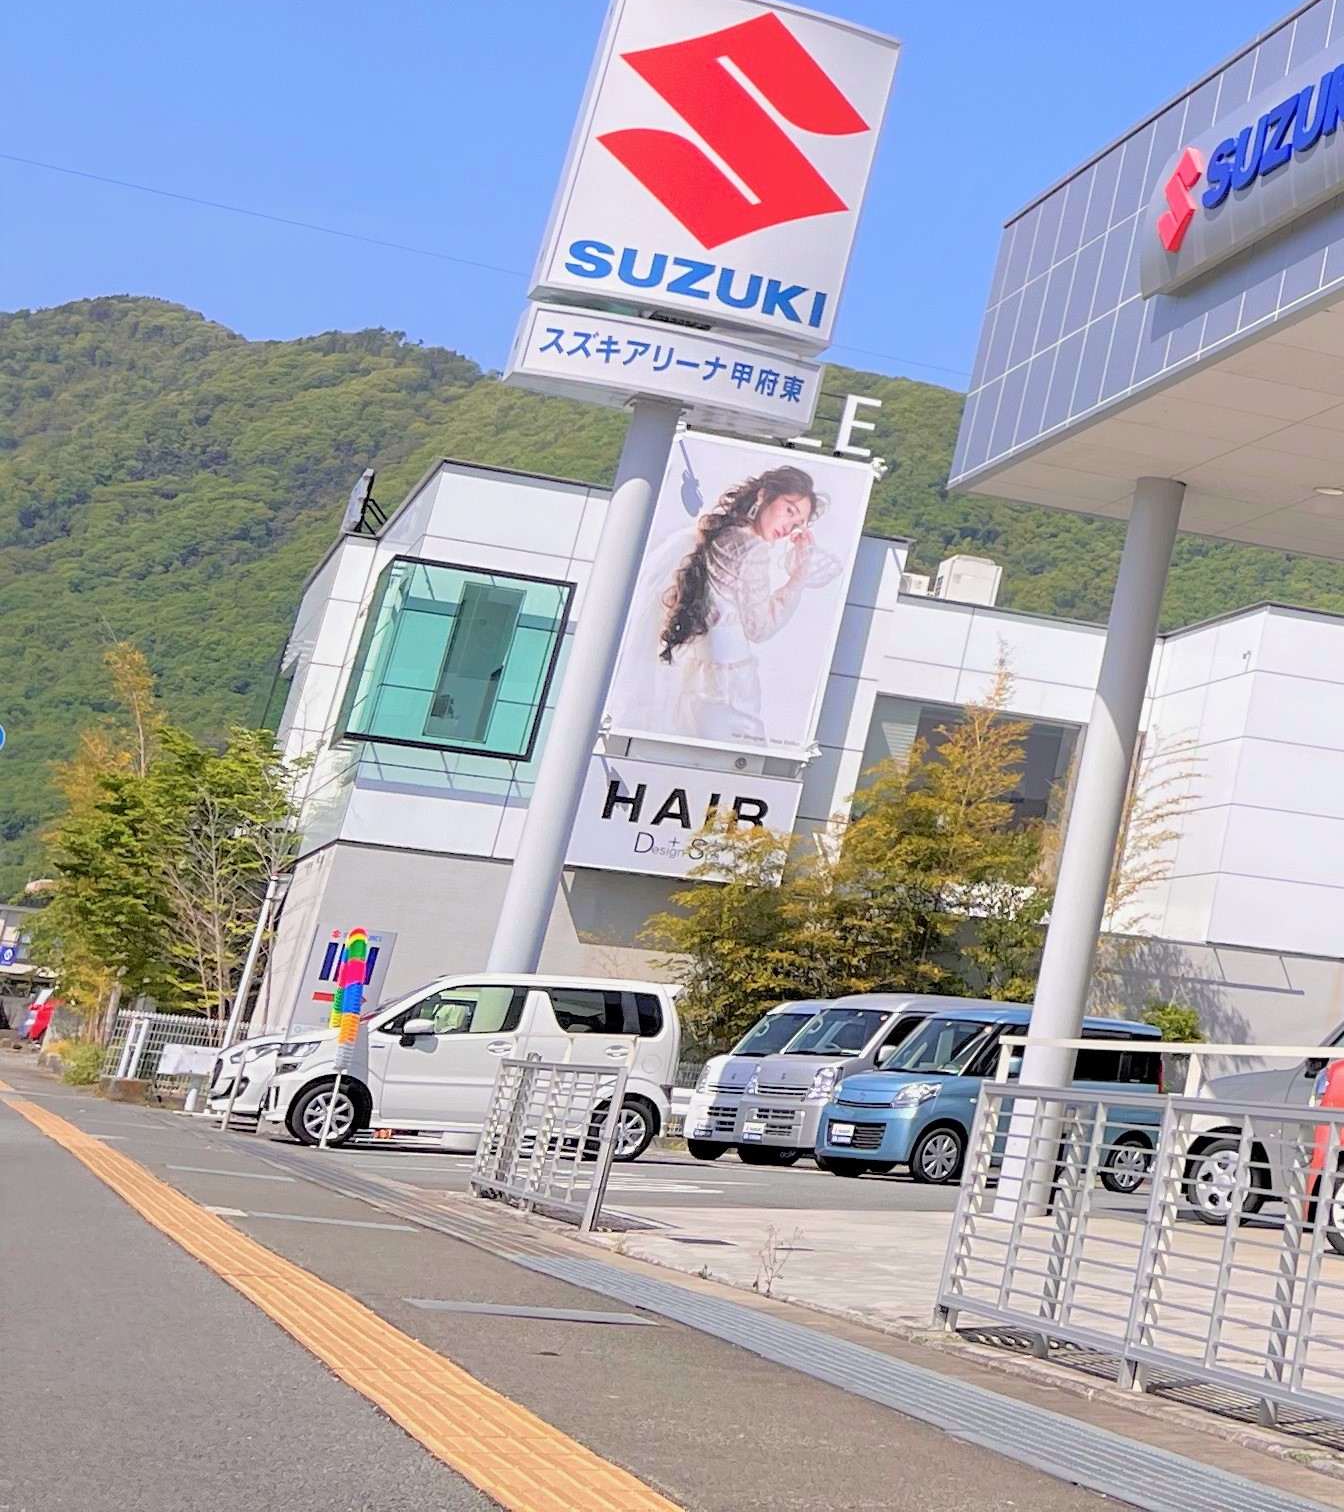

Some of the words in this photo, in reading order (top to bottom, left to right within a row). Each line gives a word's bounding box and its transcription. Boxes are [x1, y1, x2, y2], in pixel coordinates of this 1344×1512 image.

[564, 239, 828, 329] SUZUKI
[538, 326, 806, 404] スズキアリーナ甲府東
[601, 780, 769, 830] HAIR
